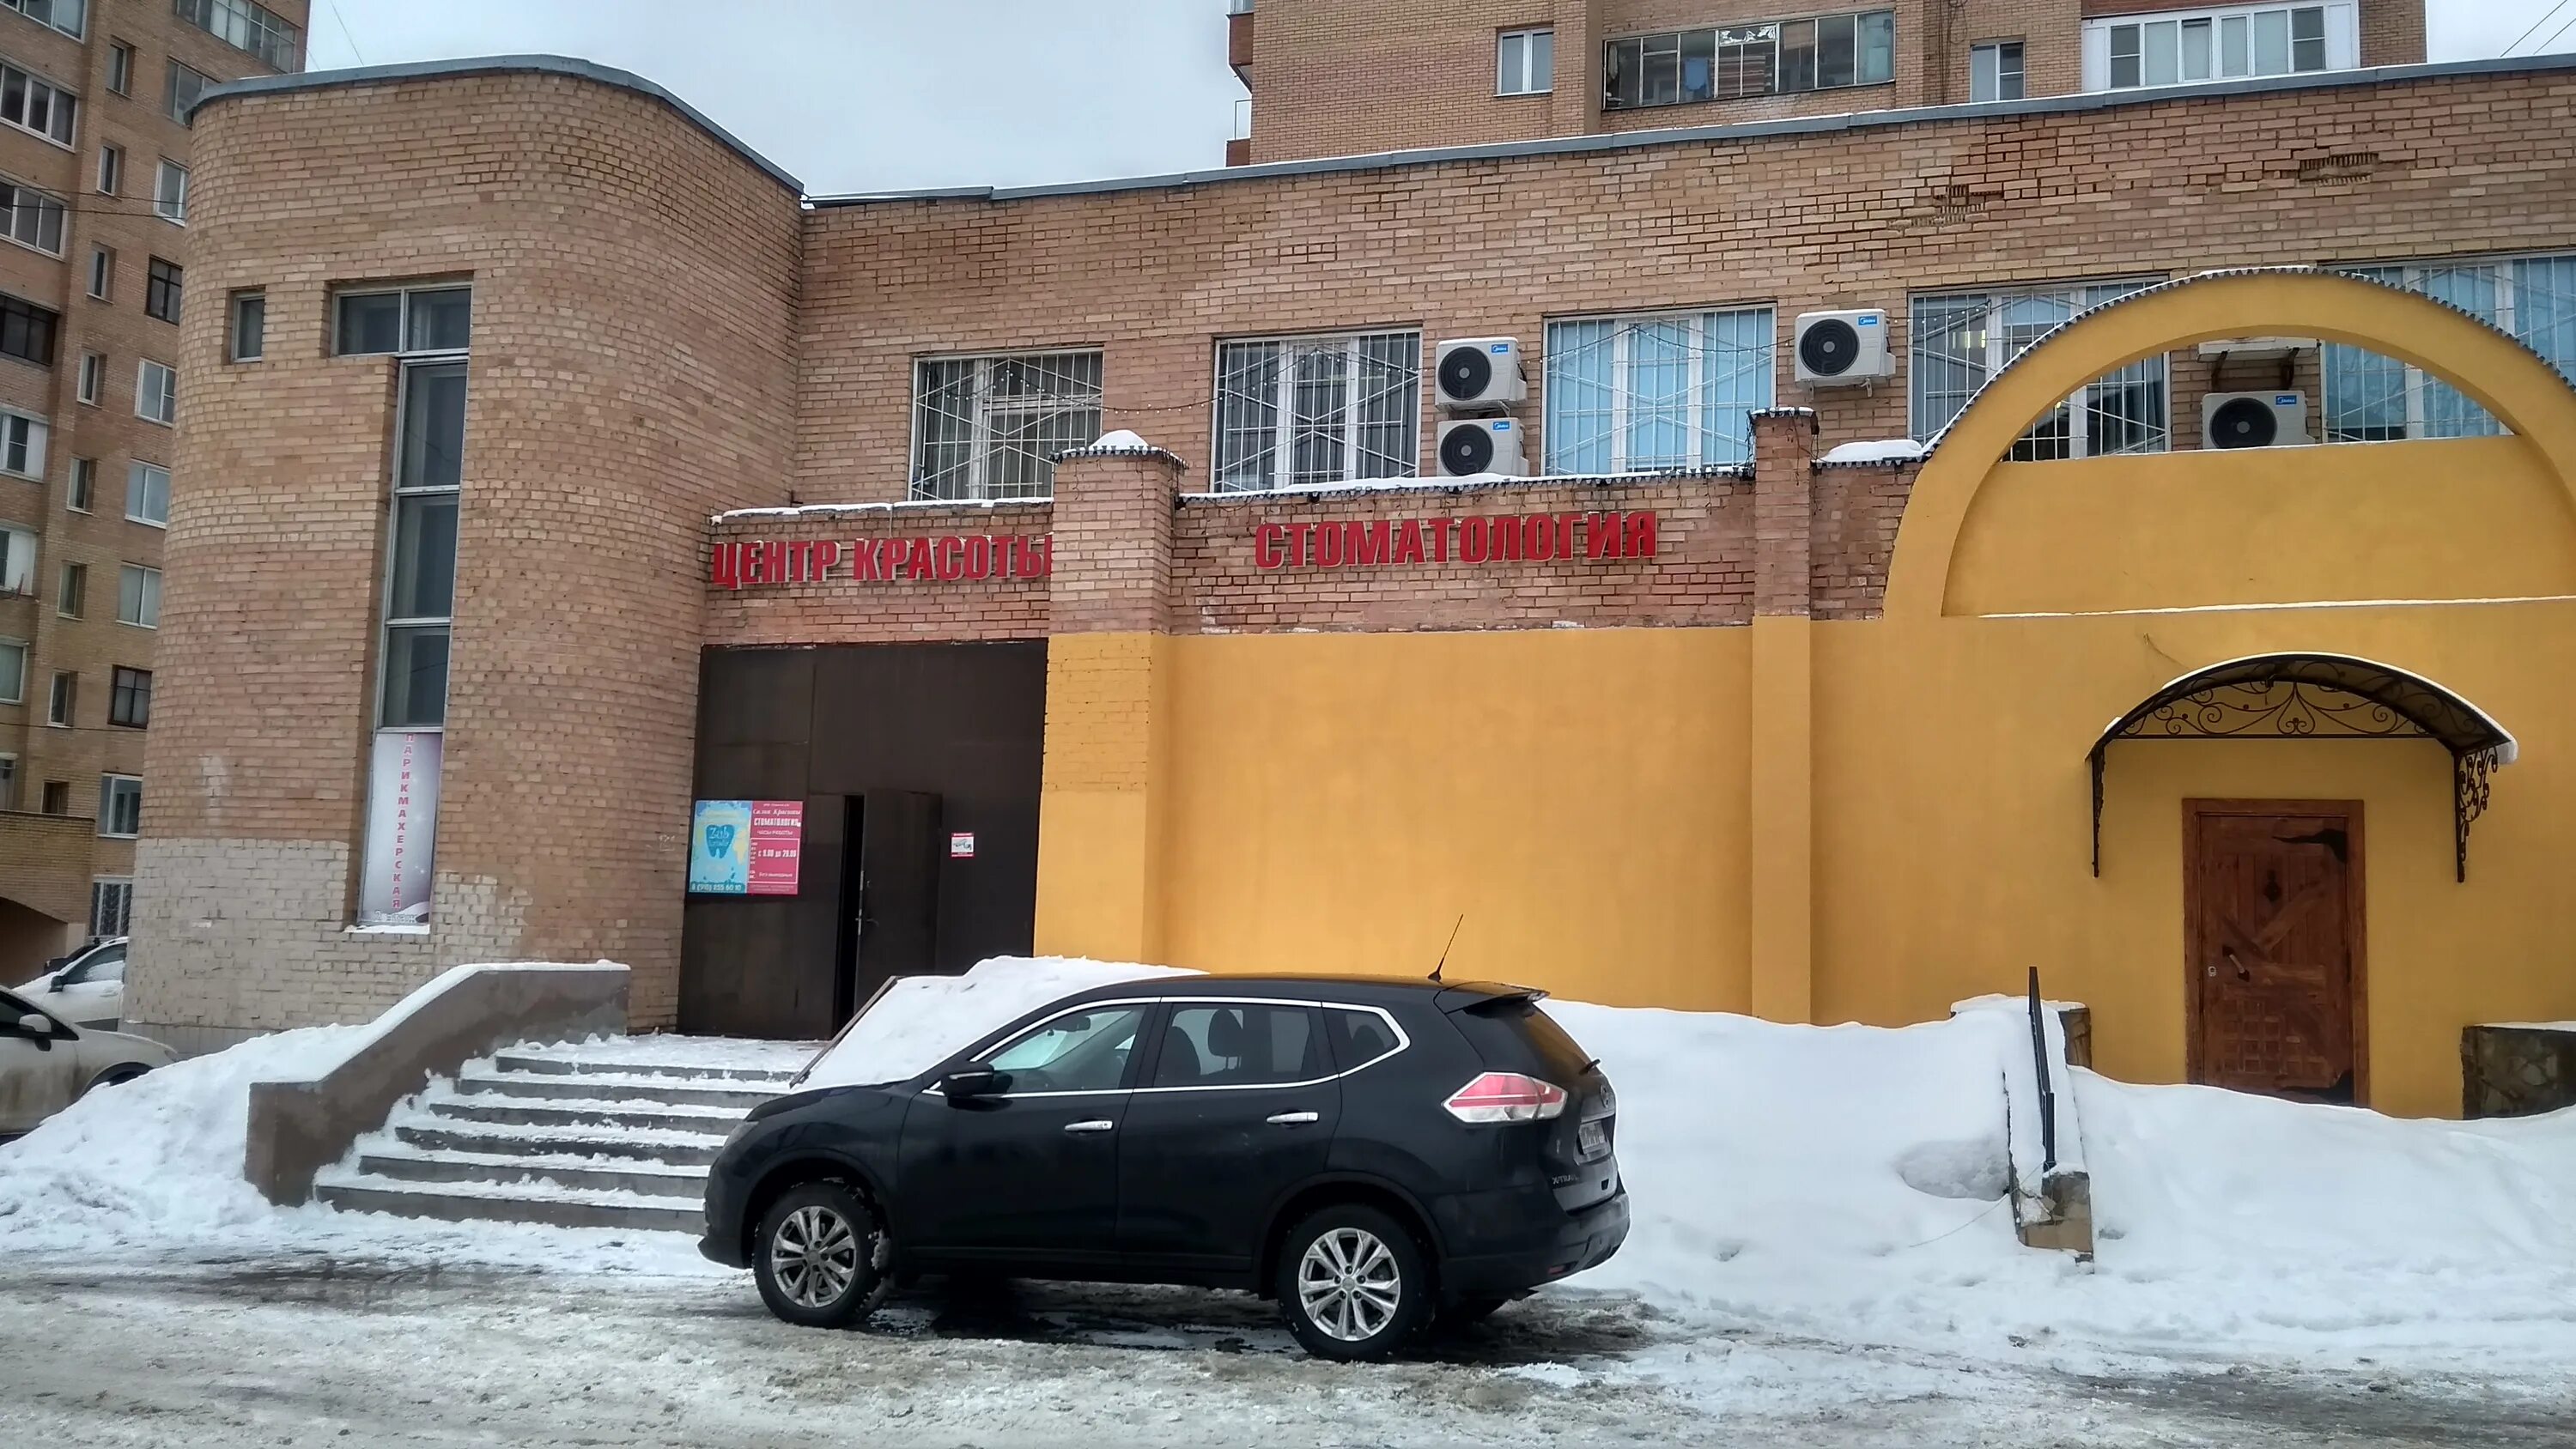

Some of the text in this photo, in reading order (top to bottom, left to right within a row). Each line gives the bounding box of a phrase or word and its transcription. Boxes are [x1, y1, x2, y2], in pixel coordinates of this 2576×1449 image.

[713, 534, 1052, 590] ЦЕНТР КРАСОТЫ
[1255, 511, 1657, 569] СТОМАТОЛОГИЯ
[392, 733, 416, 909] ПАРИКМАХЕРСКАЯ
